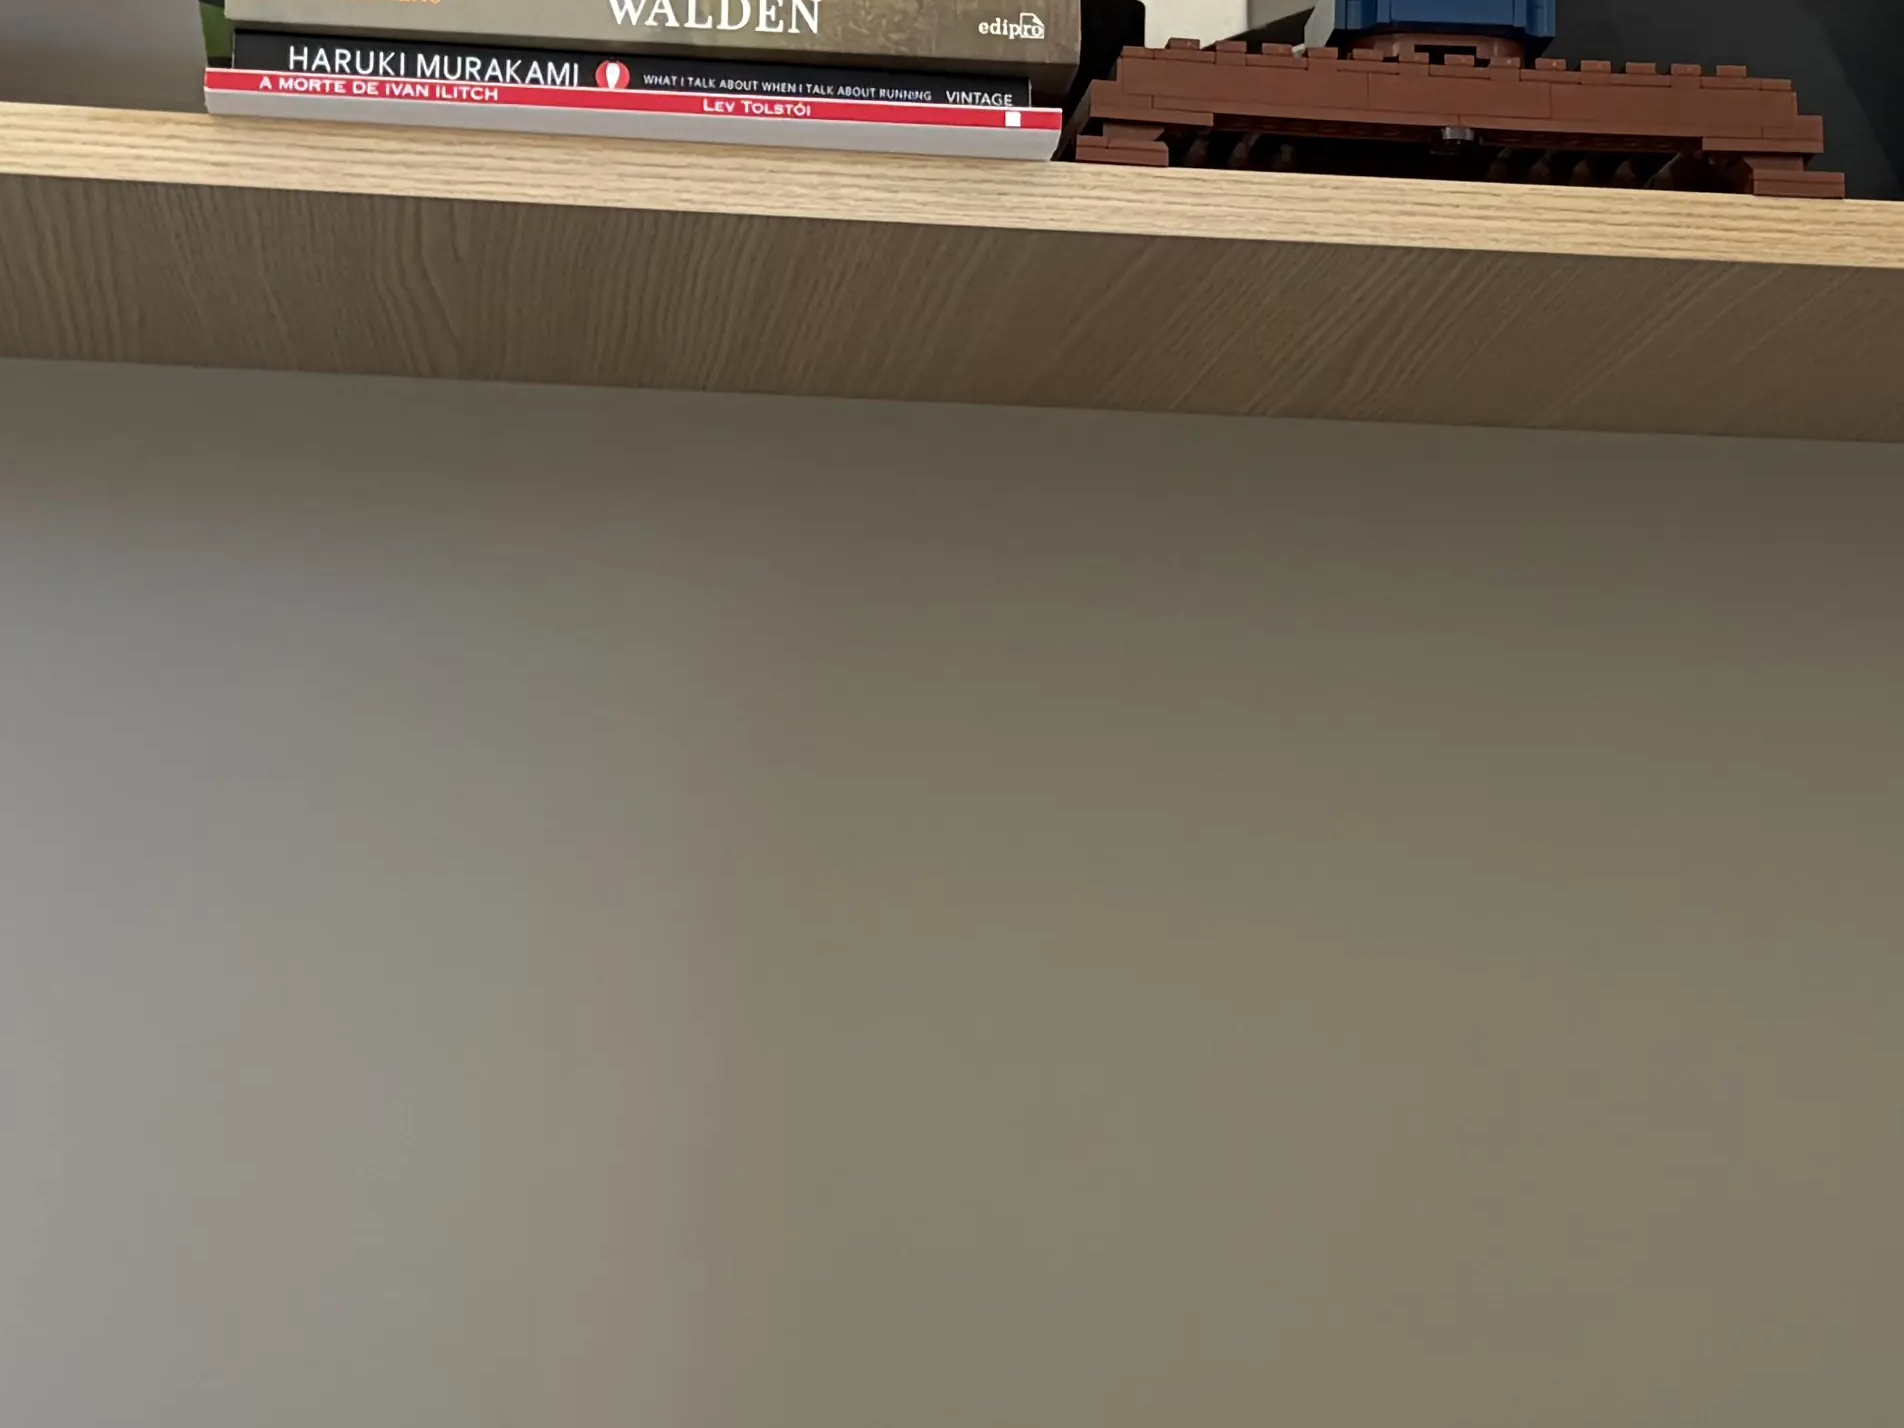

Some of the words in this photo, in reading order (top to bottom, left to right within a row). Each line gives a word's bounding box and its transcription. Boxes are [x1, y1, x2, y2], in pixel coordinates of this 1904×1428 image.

[978, 13, 1044, 40] edipro
[289, 45, 406, 76] HARUKI
[417, 53, 580, 87] MURAKAMI
[259, 76, 273, 90] A
[279, 77, 346, 94] MORTE
[352, 80, 379, 96] DE
[385, 82, 429, 98] IVAN
[435, 85, 498, 101] ILITCH
[643, 74, 678, 87] WHAT
[688, 76, 716, 89] TALK
[719, 79, 759, 91] ABOUT
[762, 81, 796, 93] WHEN
[806, 83, 834, 96] TALK
[837, 85, 876, 98] ABOUT
[879, 88, 932, 101] RUNNING
[946, 90, 1013, 107] VINTAGE
